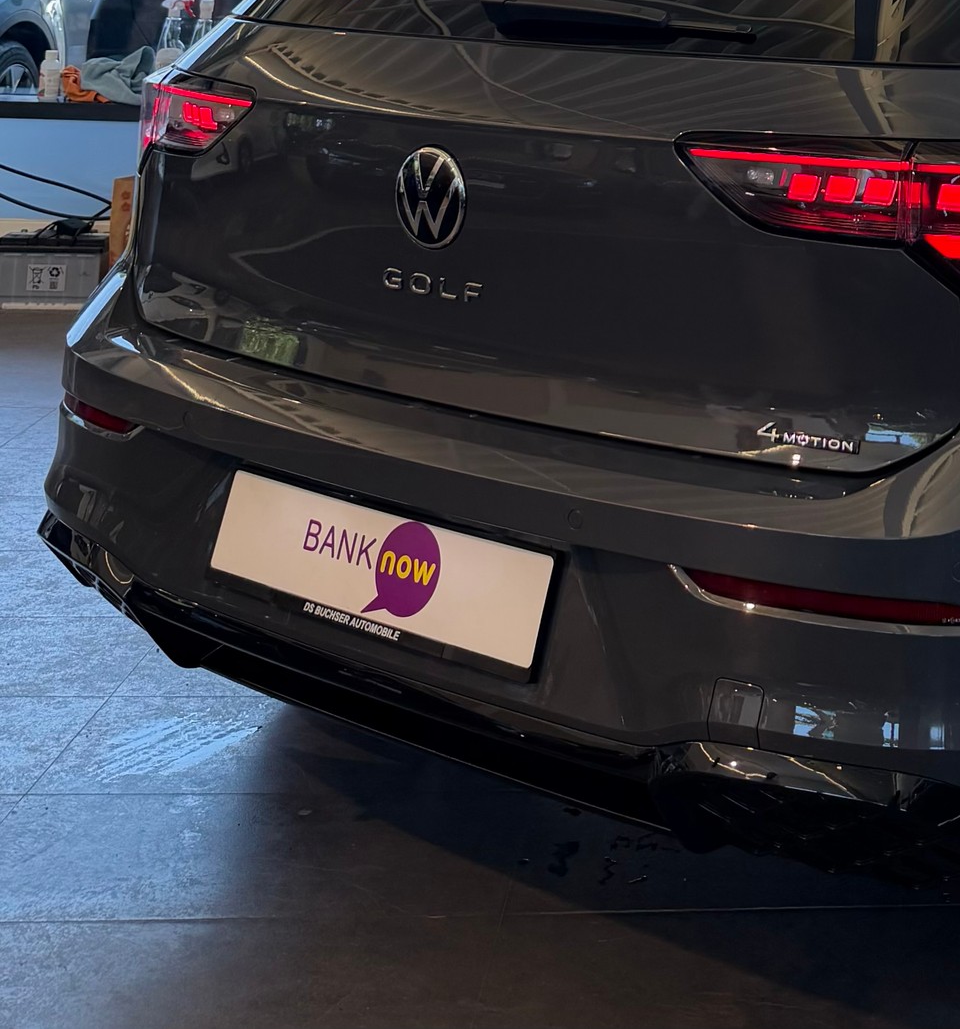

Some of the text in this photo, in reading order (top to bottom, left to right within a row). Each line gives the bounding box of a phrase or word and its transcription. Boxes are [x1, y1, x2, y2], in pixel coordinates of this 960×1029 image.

[396, 147, 467, 249] VW
[383, 267, 484, 303] GOLF
[303, 519, 437, 586] BANK now
[302, 601, 401, 642] DS BUCHSER AUTOMOBILE
